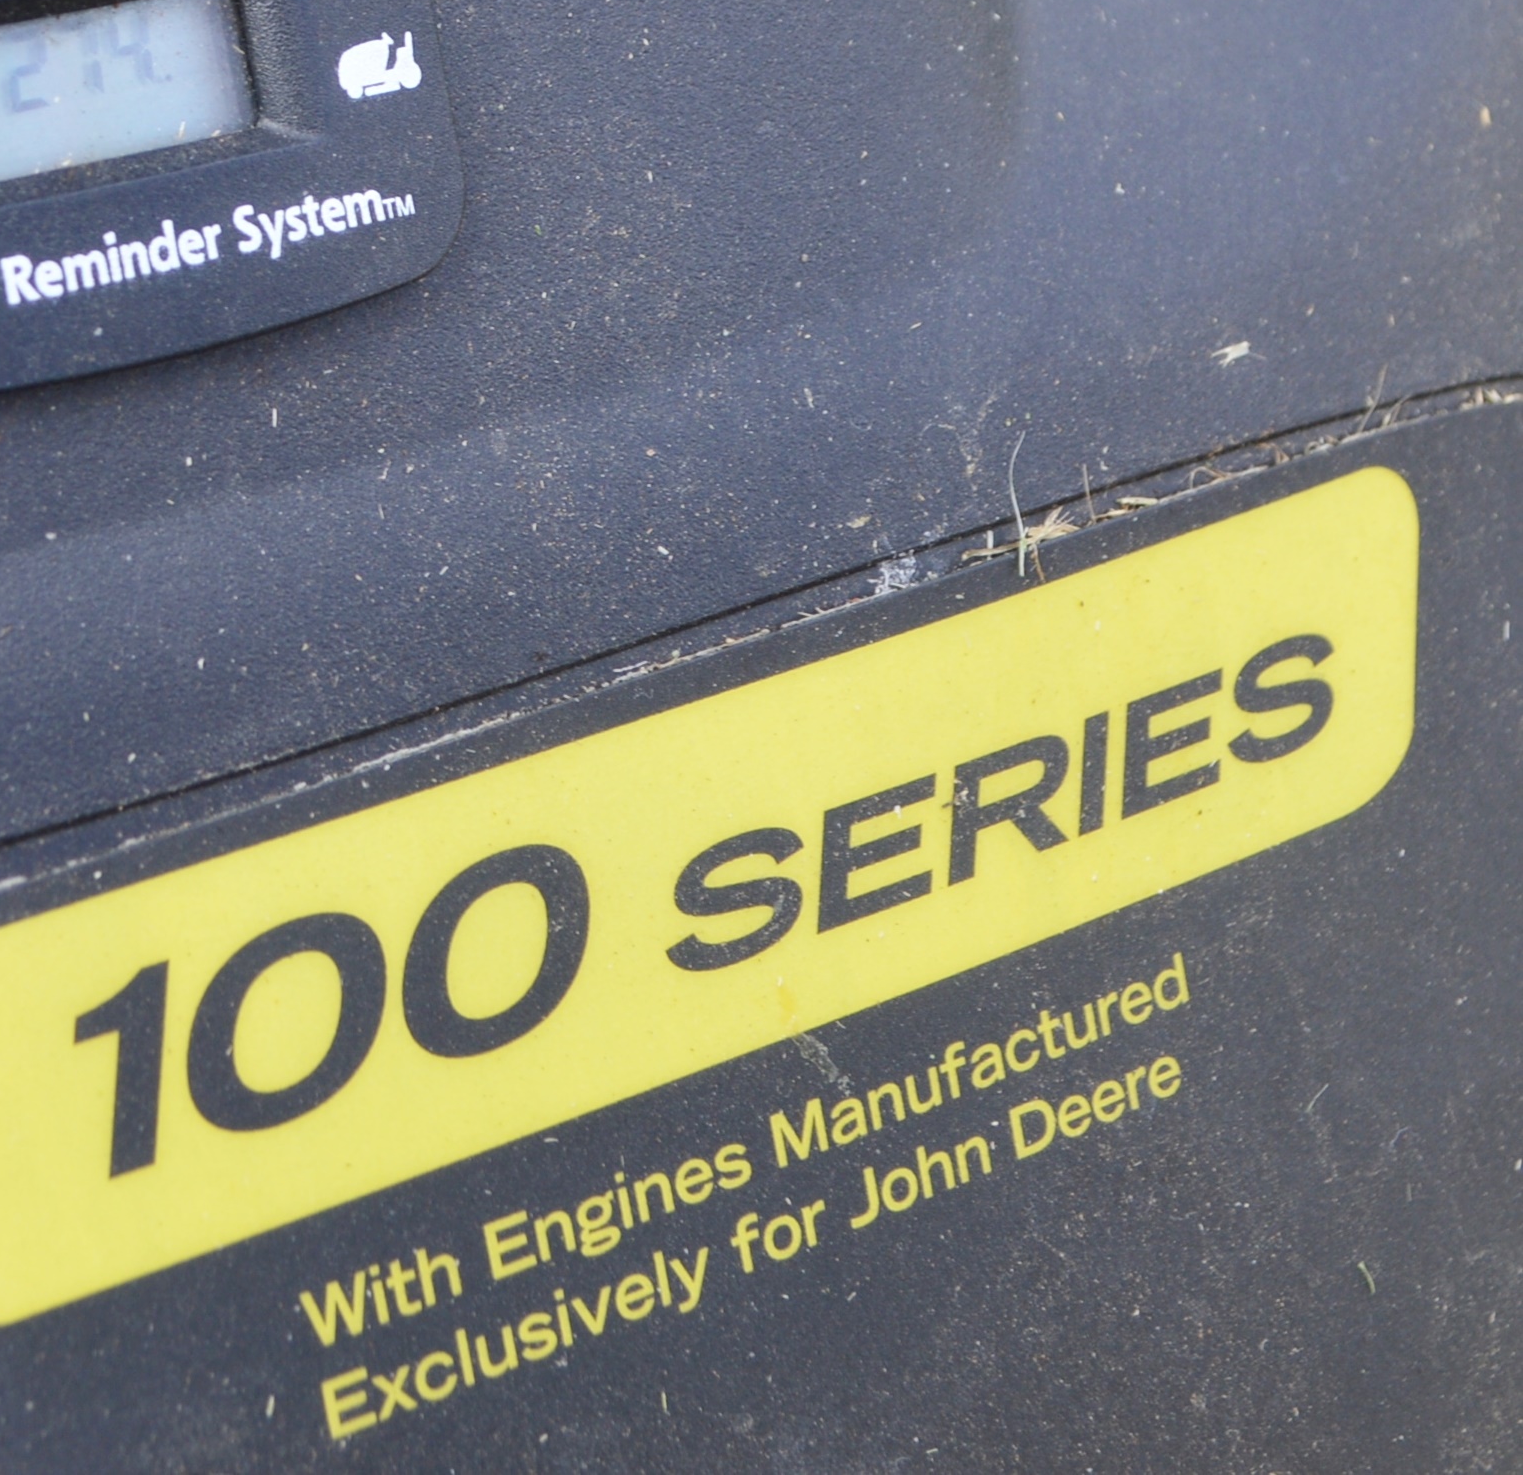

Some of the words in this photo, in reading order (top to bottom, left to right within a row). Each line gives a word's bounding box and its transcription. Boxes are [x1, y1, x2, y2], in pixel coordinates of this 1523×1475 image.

[0, 218, 222, 306] Reminder
[74, 844, 590, 1178] 100
[666, 635, 1333, 972] SERIES
[300, 1248, 463, 1347] With
[483, 1143, 753, 1281] Engines
[769, 952, 1191, 1168] Manufactured
[321, 1247, 710, 1440] Exclusively
[730, 1199, 826, 1274] for
[850, 1135, 993, 1230] John
[1009, 1056, 1182, 1160] Deere
